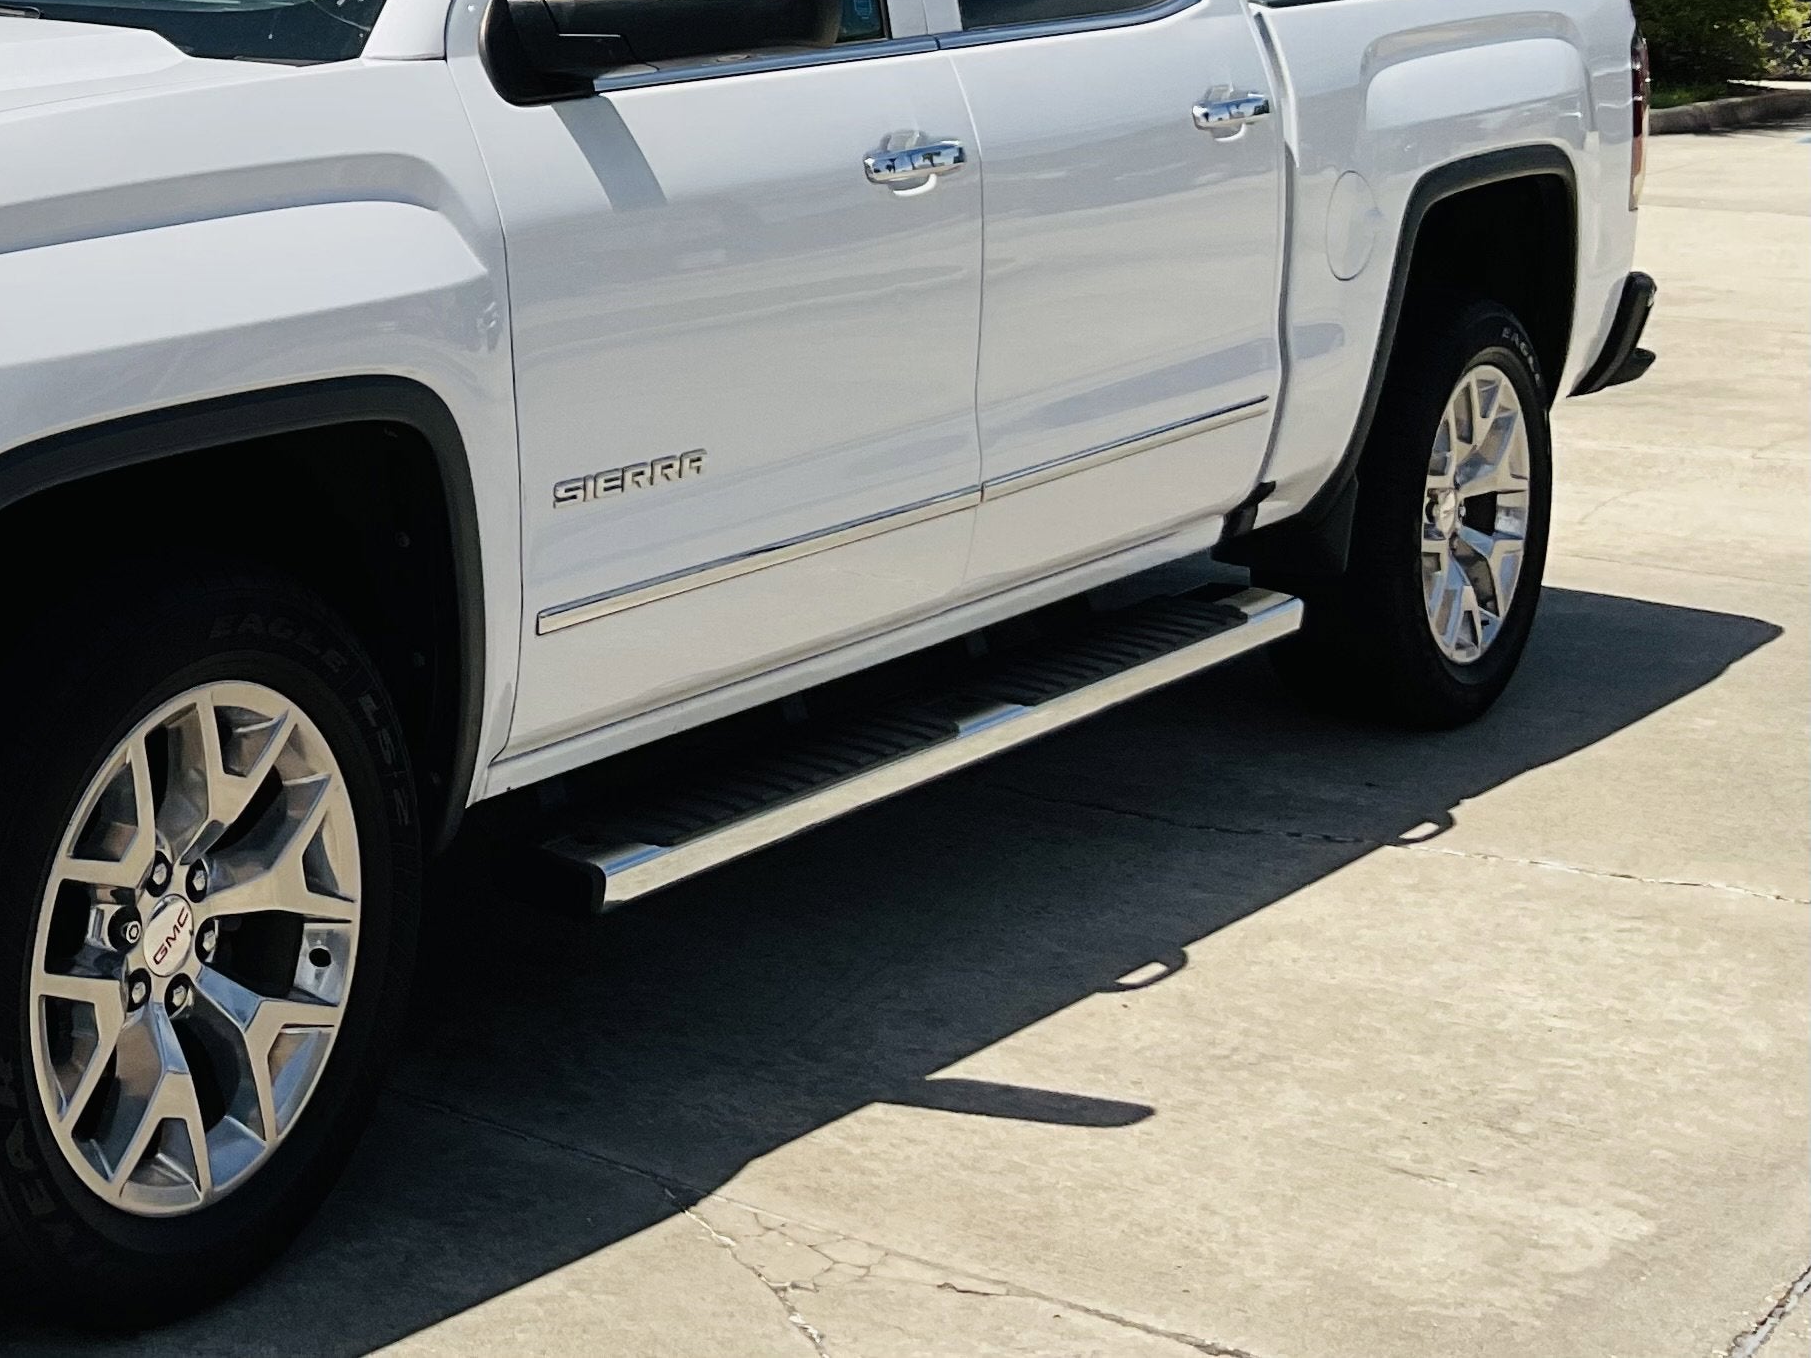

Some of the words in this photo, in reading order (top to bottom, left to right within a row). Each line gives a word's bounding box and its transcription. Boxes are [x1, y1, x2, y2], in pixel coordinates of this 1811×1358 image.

[553, 447, 708, 509] SIERRA
[208, 612, 348, 674] EAGLE
[152, 906, 189, 965] GMC
